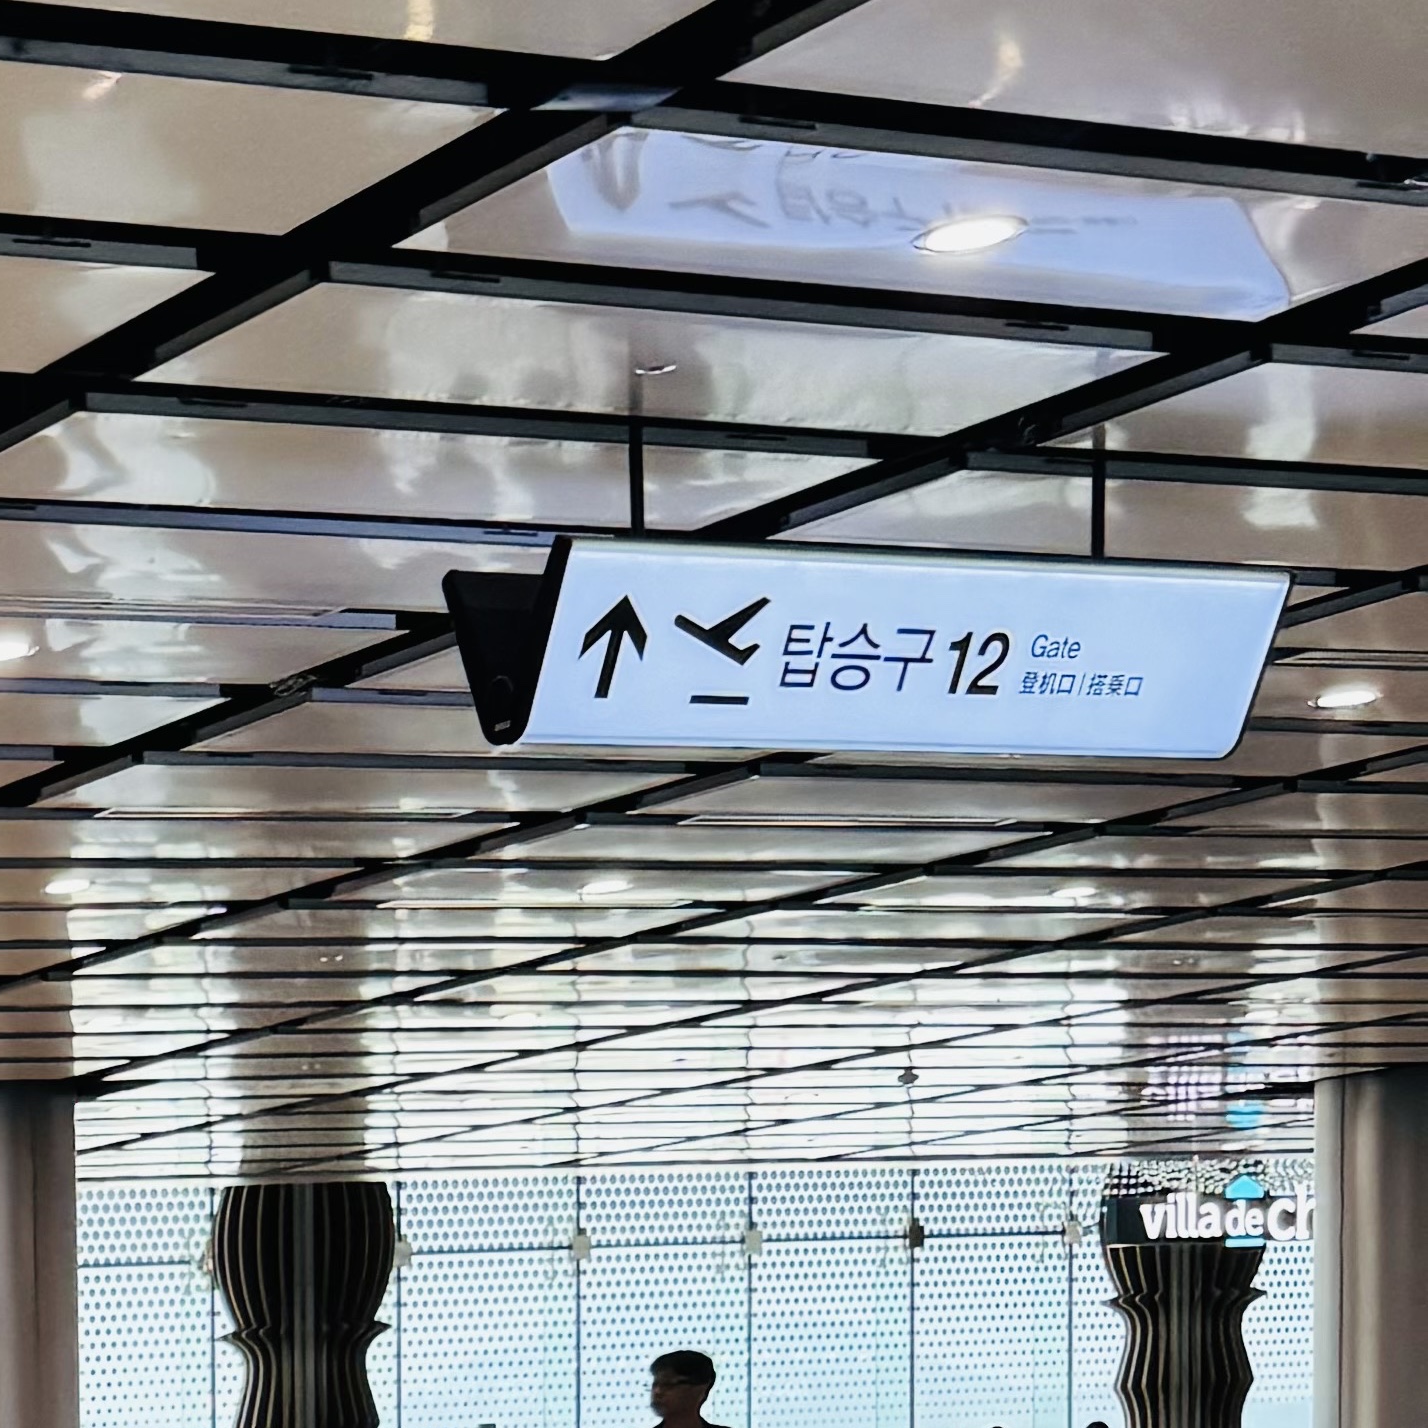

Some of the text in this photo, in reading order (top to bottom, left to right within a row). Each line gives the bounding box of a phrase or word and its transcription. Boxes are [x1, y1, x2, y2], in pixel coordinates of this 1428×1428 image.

[779, 621, 1010, 695] 탑승구 12
[1030, 633, 1082, 659] Gate
